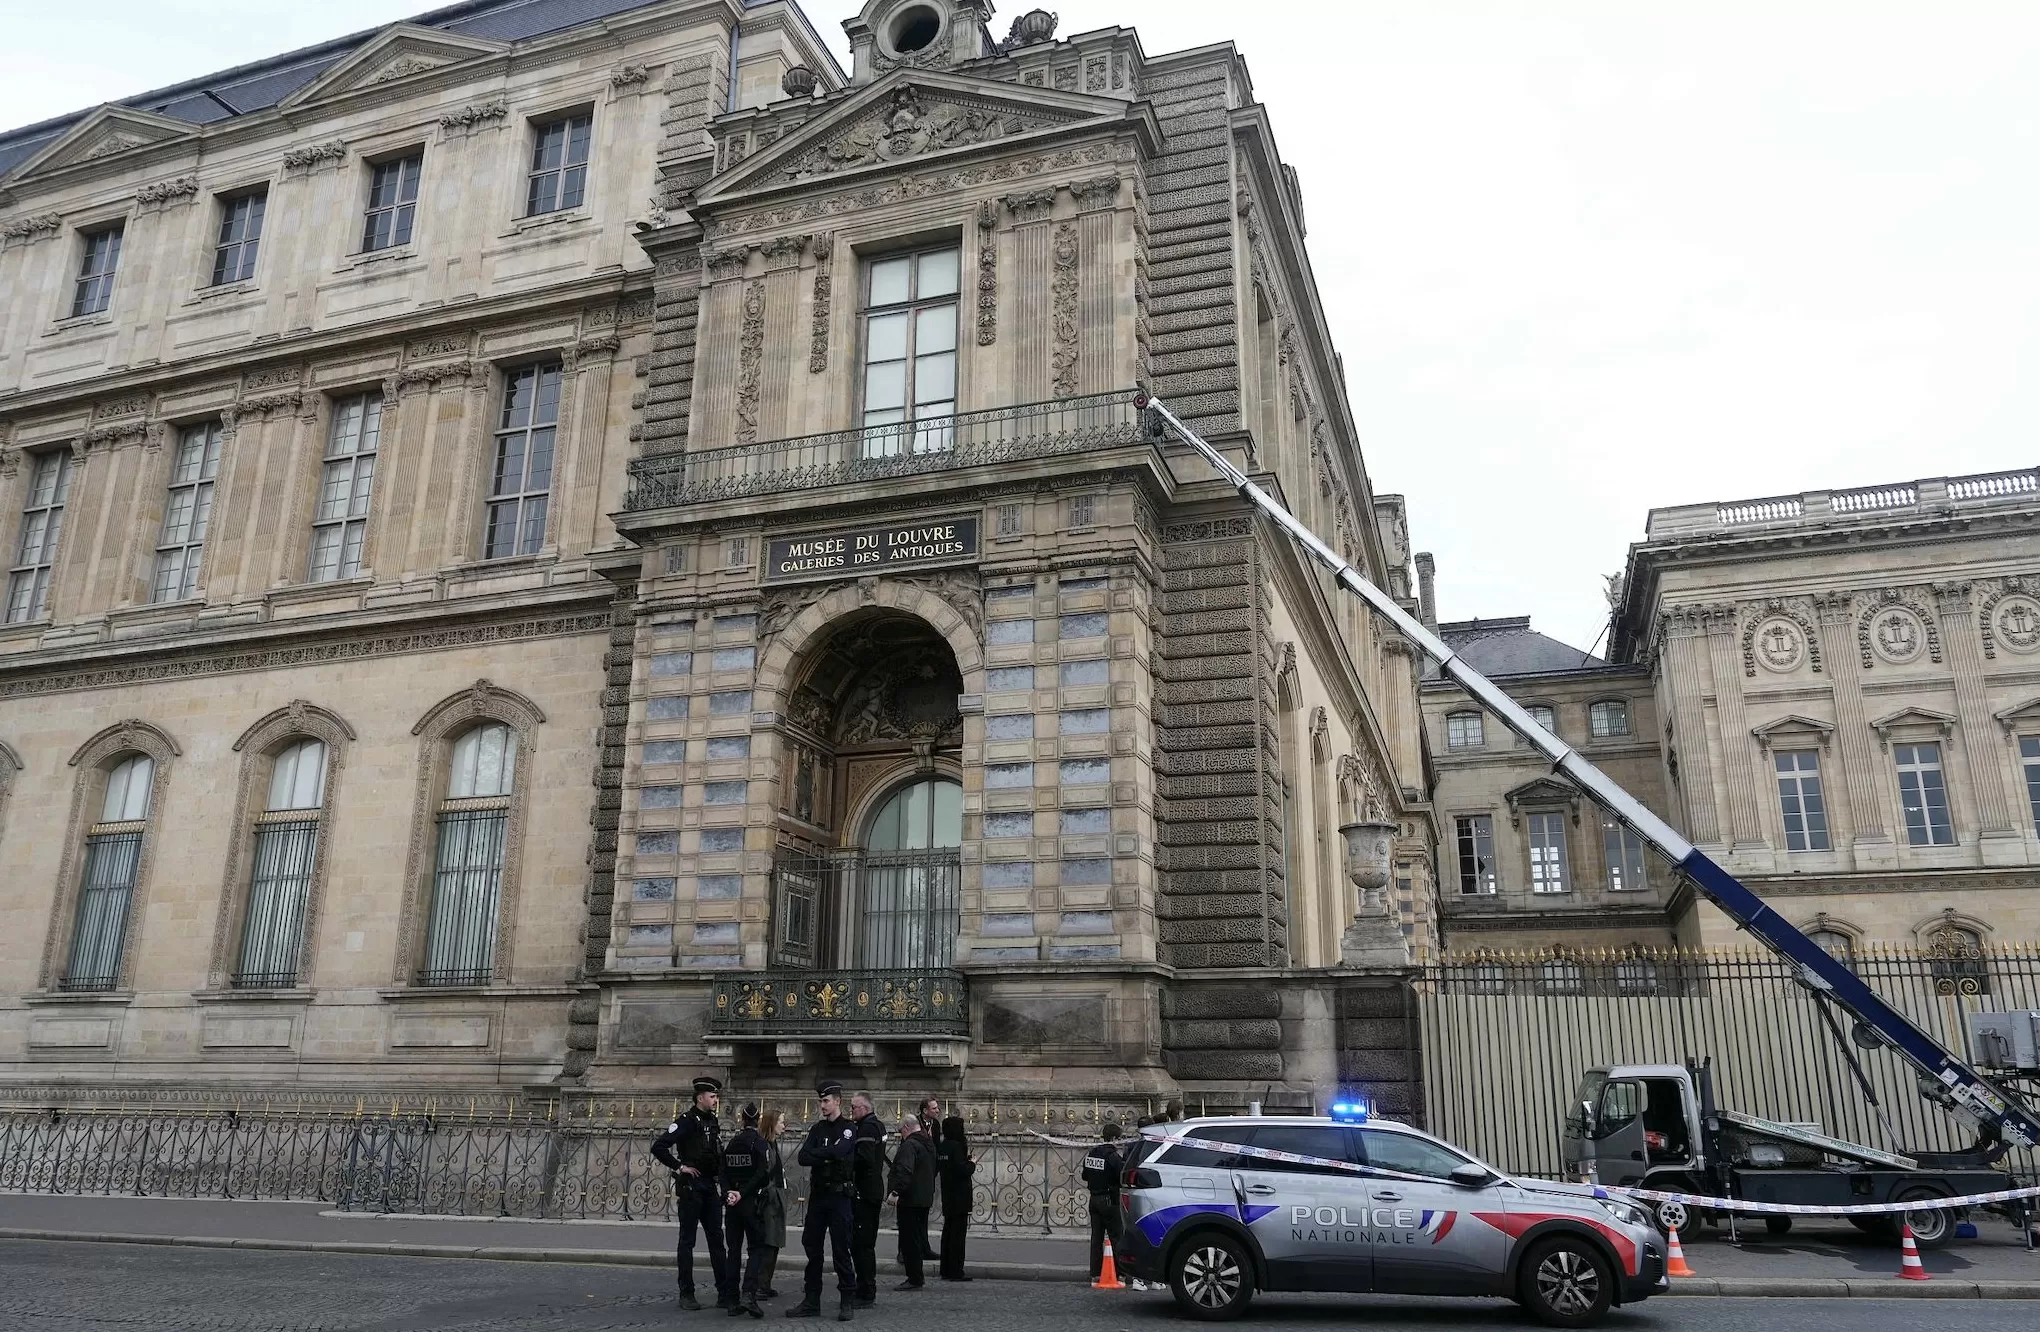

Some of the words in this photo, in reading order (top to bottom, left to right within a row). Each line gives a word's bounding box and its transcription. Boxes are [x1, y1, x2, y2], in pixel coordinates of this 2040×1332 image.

[788, 538, 846, 557] MUSÉE
[856, 534, 880, 550] DU
[888, 526, 956, 546] LOUVRE
[781, 556, 845, 572] GALERIES
[854, 551, 880, 564] DES
[890, 541, 964, 560] ANTIQUES
[1086, 1157, 1104, 1169] POLICE
[1290, 1205, 1414, 1228] POLICE
[1292, 1229, 1415, 1244] NATIONALE
